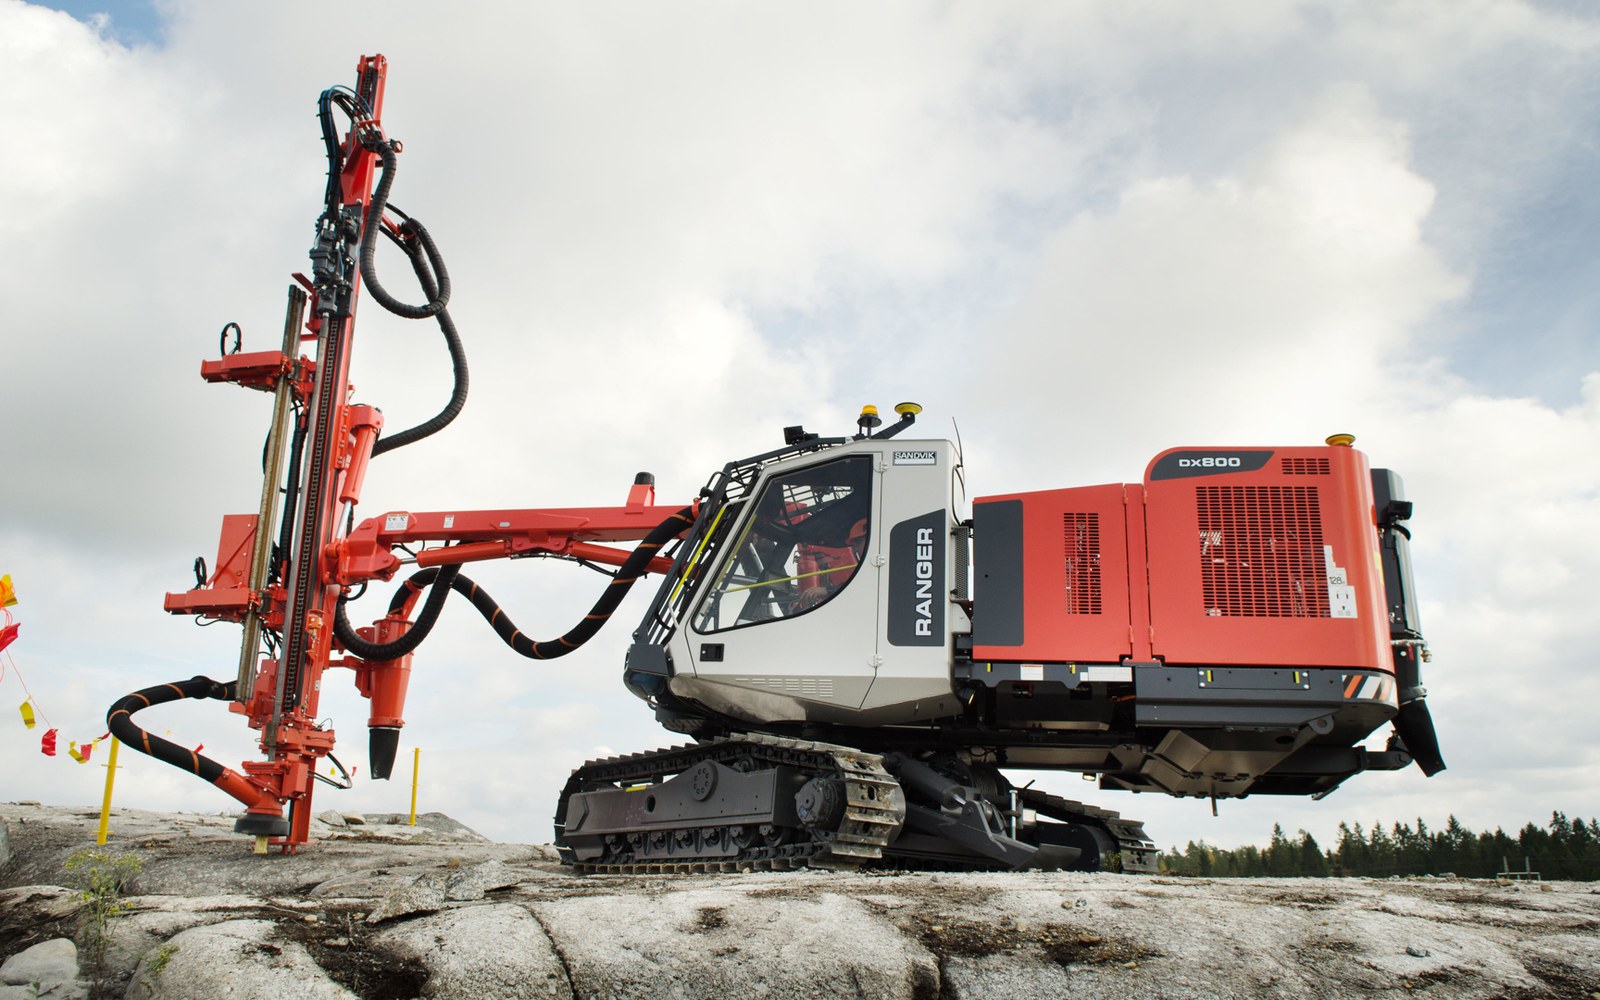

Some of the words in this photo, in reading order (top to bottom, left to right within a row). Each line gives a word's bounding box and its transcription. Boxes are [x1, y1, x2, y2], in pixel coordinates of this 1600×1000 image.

[894, 452, 935, 460] SANDVIK
[1179, 457, 1241, 467] DX800
[915, 528, 933, 636] RANGER
